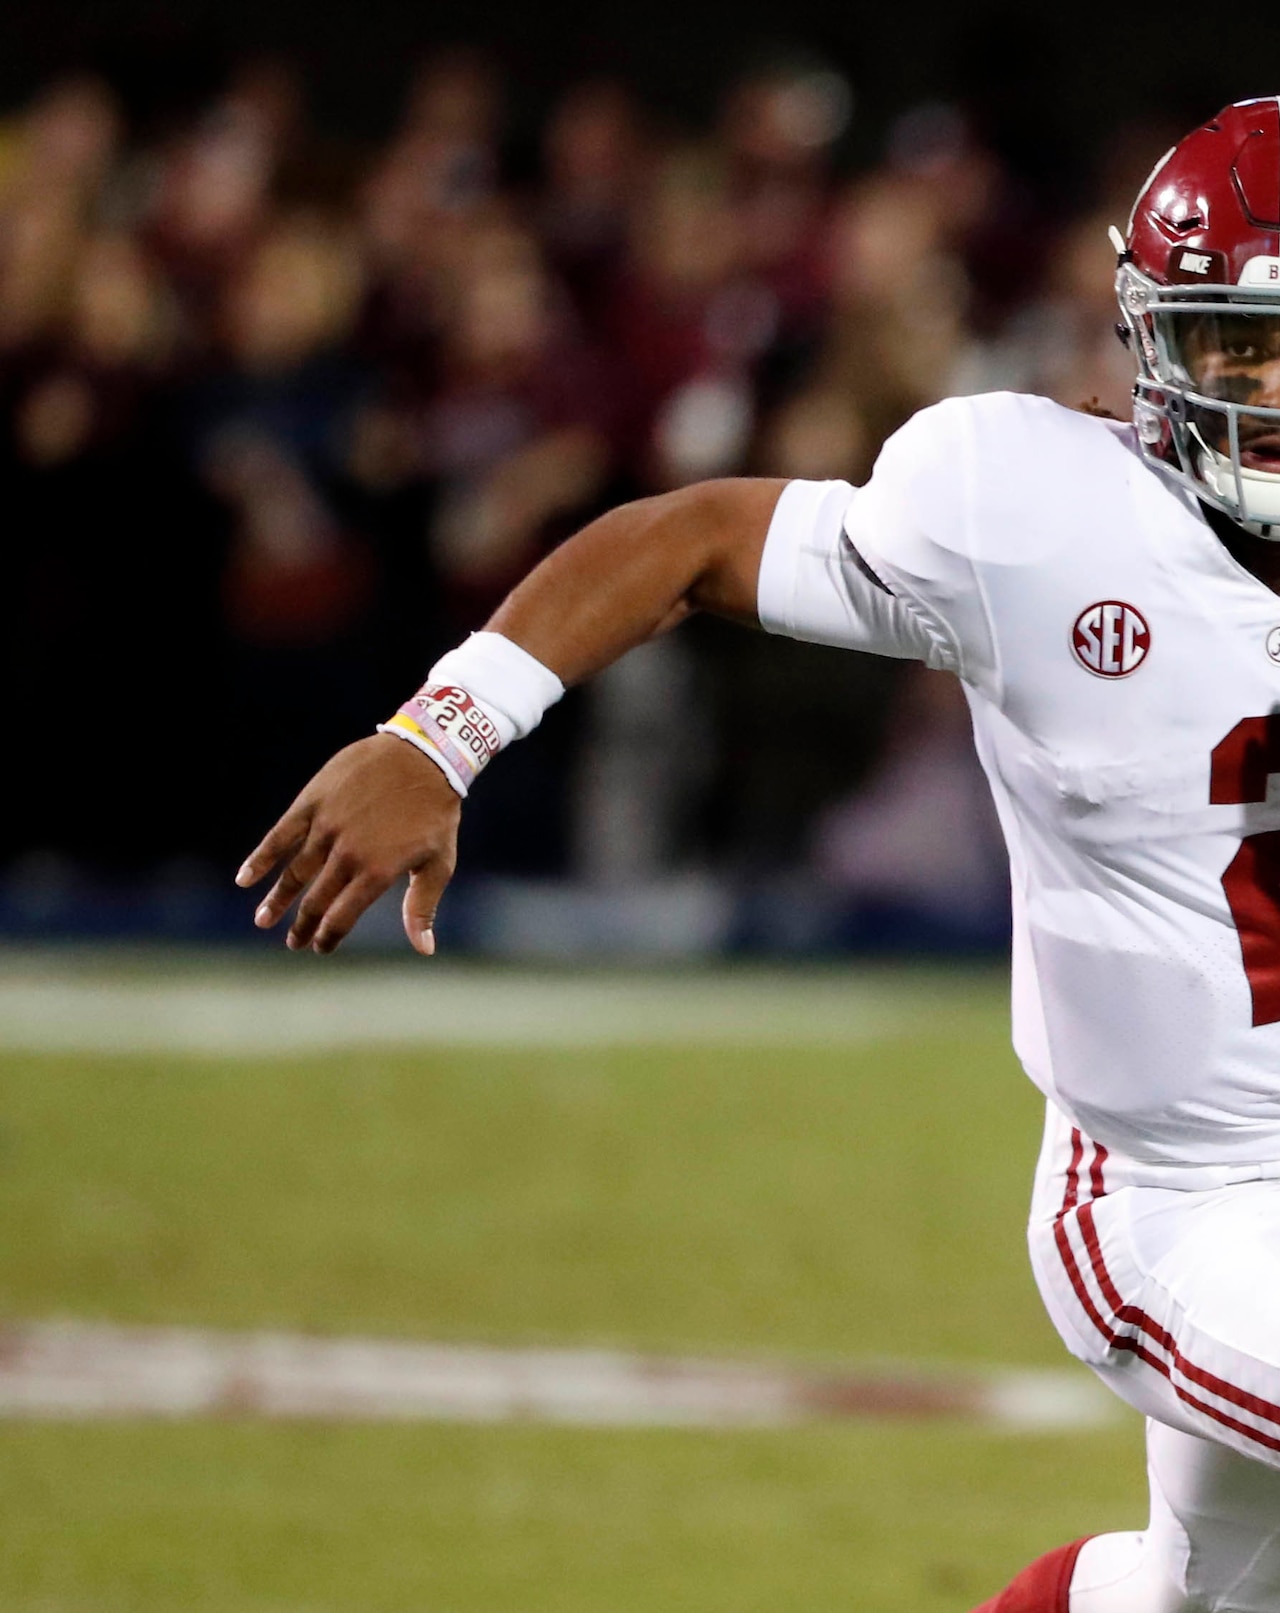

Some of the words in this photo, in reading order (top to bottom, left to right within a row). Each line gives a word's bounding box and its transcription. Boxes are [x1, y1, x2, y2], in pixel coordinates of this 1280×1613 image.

[1076, 604, 1147, 673] SEC
[436, 706, 457, 731] 2
[458, 725, 490, 766] GOD
[441, 688, 467, 708] 2
[465, 706, 501, 751] GOD
